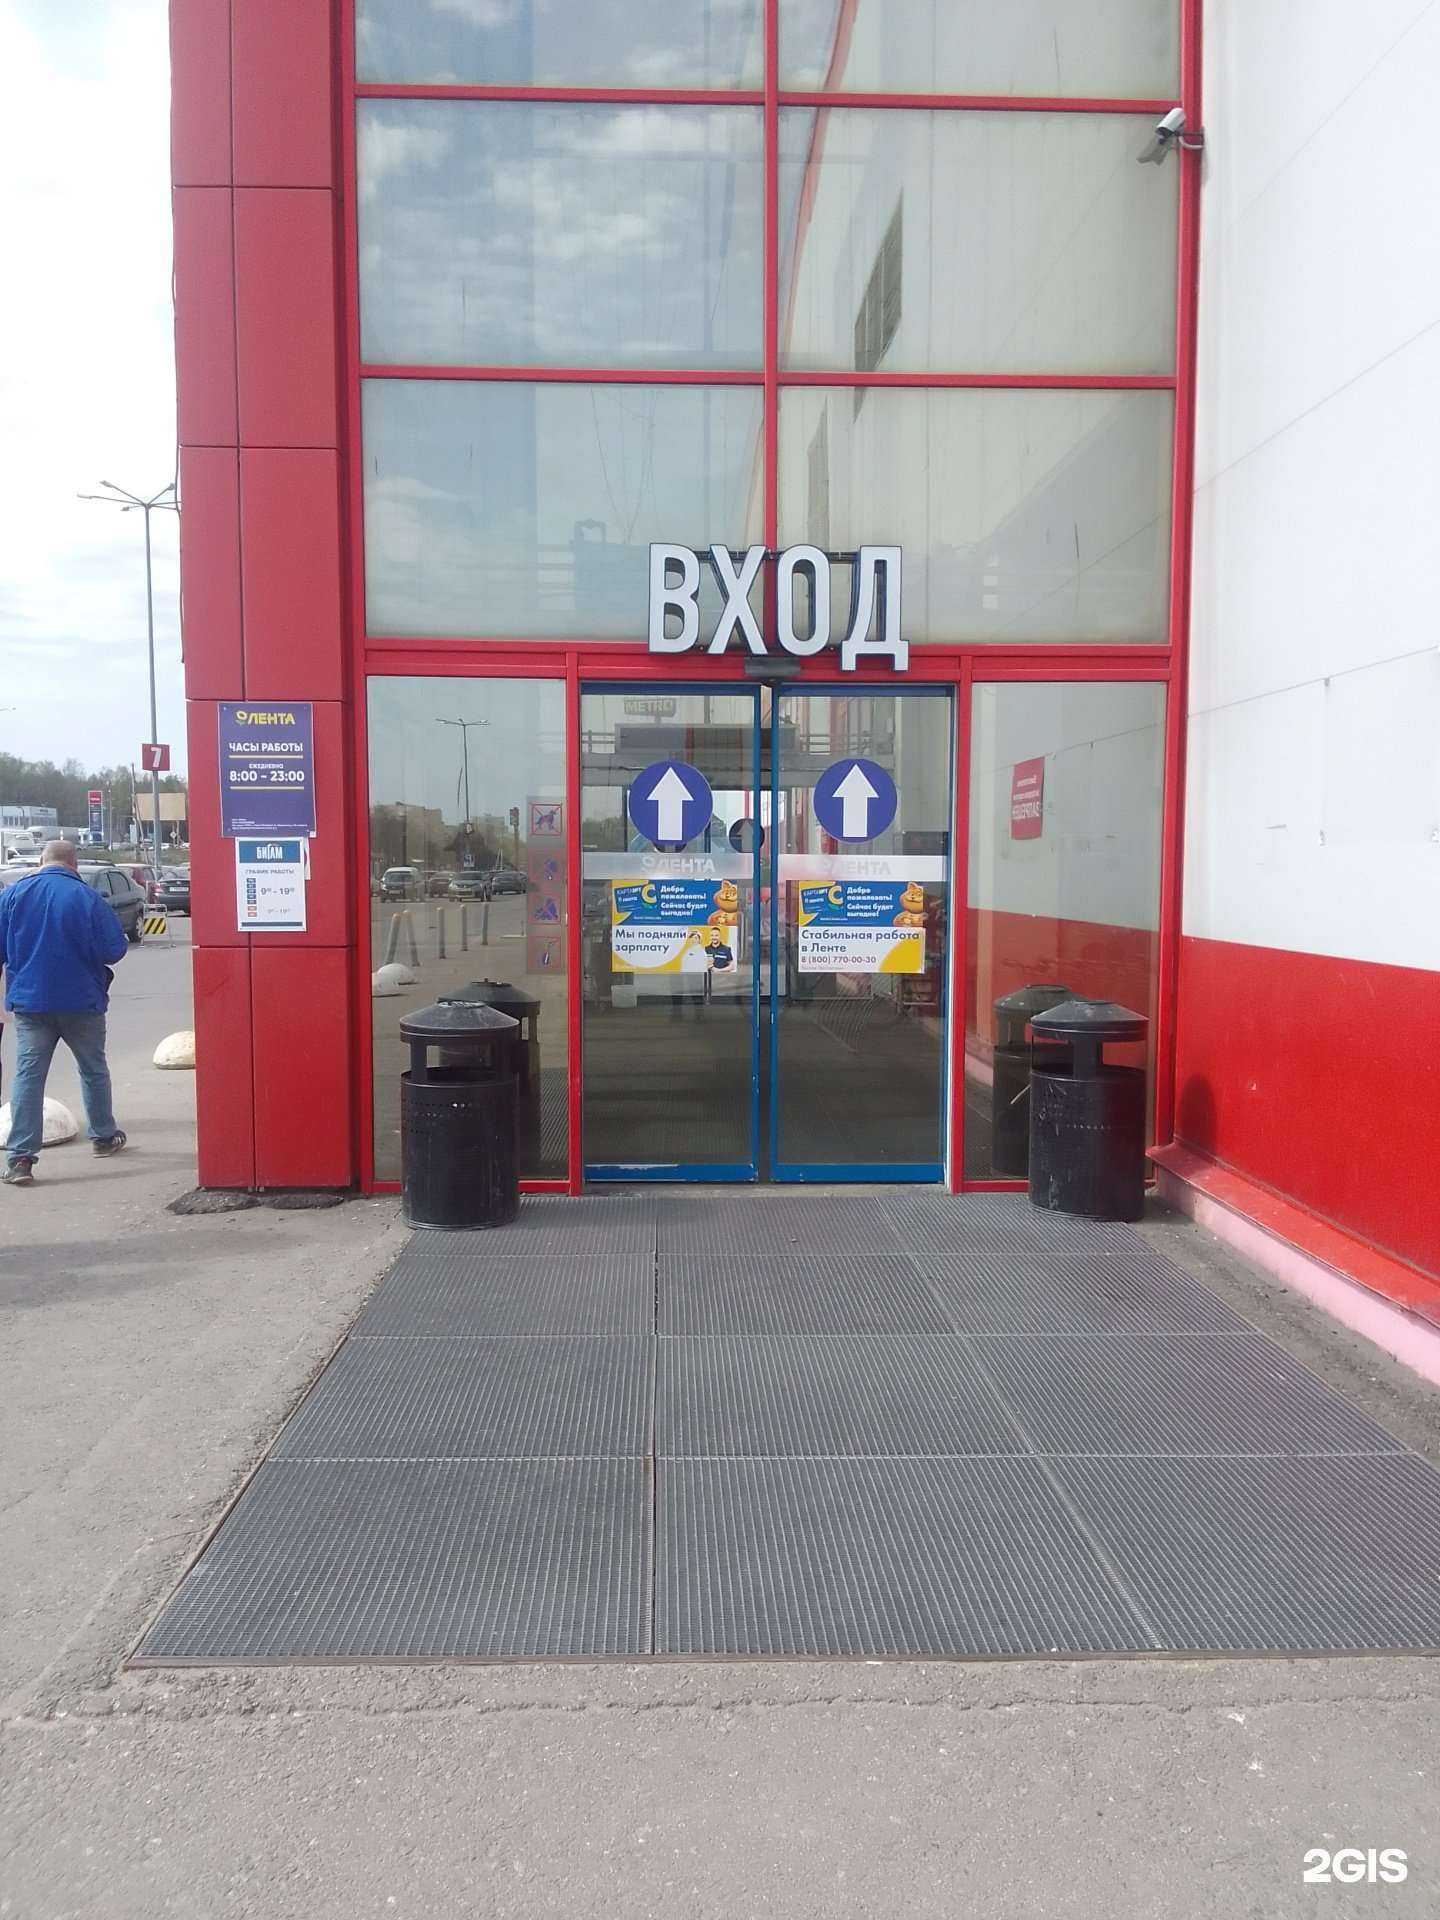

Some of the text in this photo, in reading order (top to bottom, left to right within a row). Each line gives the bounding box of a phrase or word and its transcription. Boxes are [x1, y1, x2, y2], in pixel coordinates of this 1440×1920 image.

[648, 542, 910, 672] ВХОД
[248, 712, 295, 725] ЛЕНТА
[228, 742, 304, 752] ЧАСЫ РАБОТЫ
[150, 746, 162, 768] 7
[229, 770, 258, 781] 8:00
[270, 770, 305, 782] 23:00
[658, 858, 716, 873] ЛЕНТА
[660, 885, 685, 893] Добро
[847, 886, 872, 895] Добро
[686, 902, 707, 911] будет
[872, 902, 894, 912] будет
[615, 928, 687, 941] Мы подняли
[801, 929, 920, 942] Стабильная работа
[615, 944, 670, 954] зарплату
[810, 943, 847, 952] Ленте
[801, 955, 807, 963] 8
[808, 955, 831, 964] (800)
